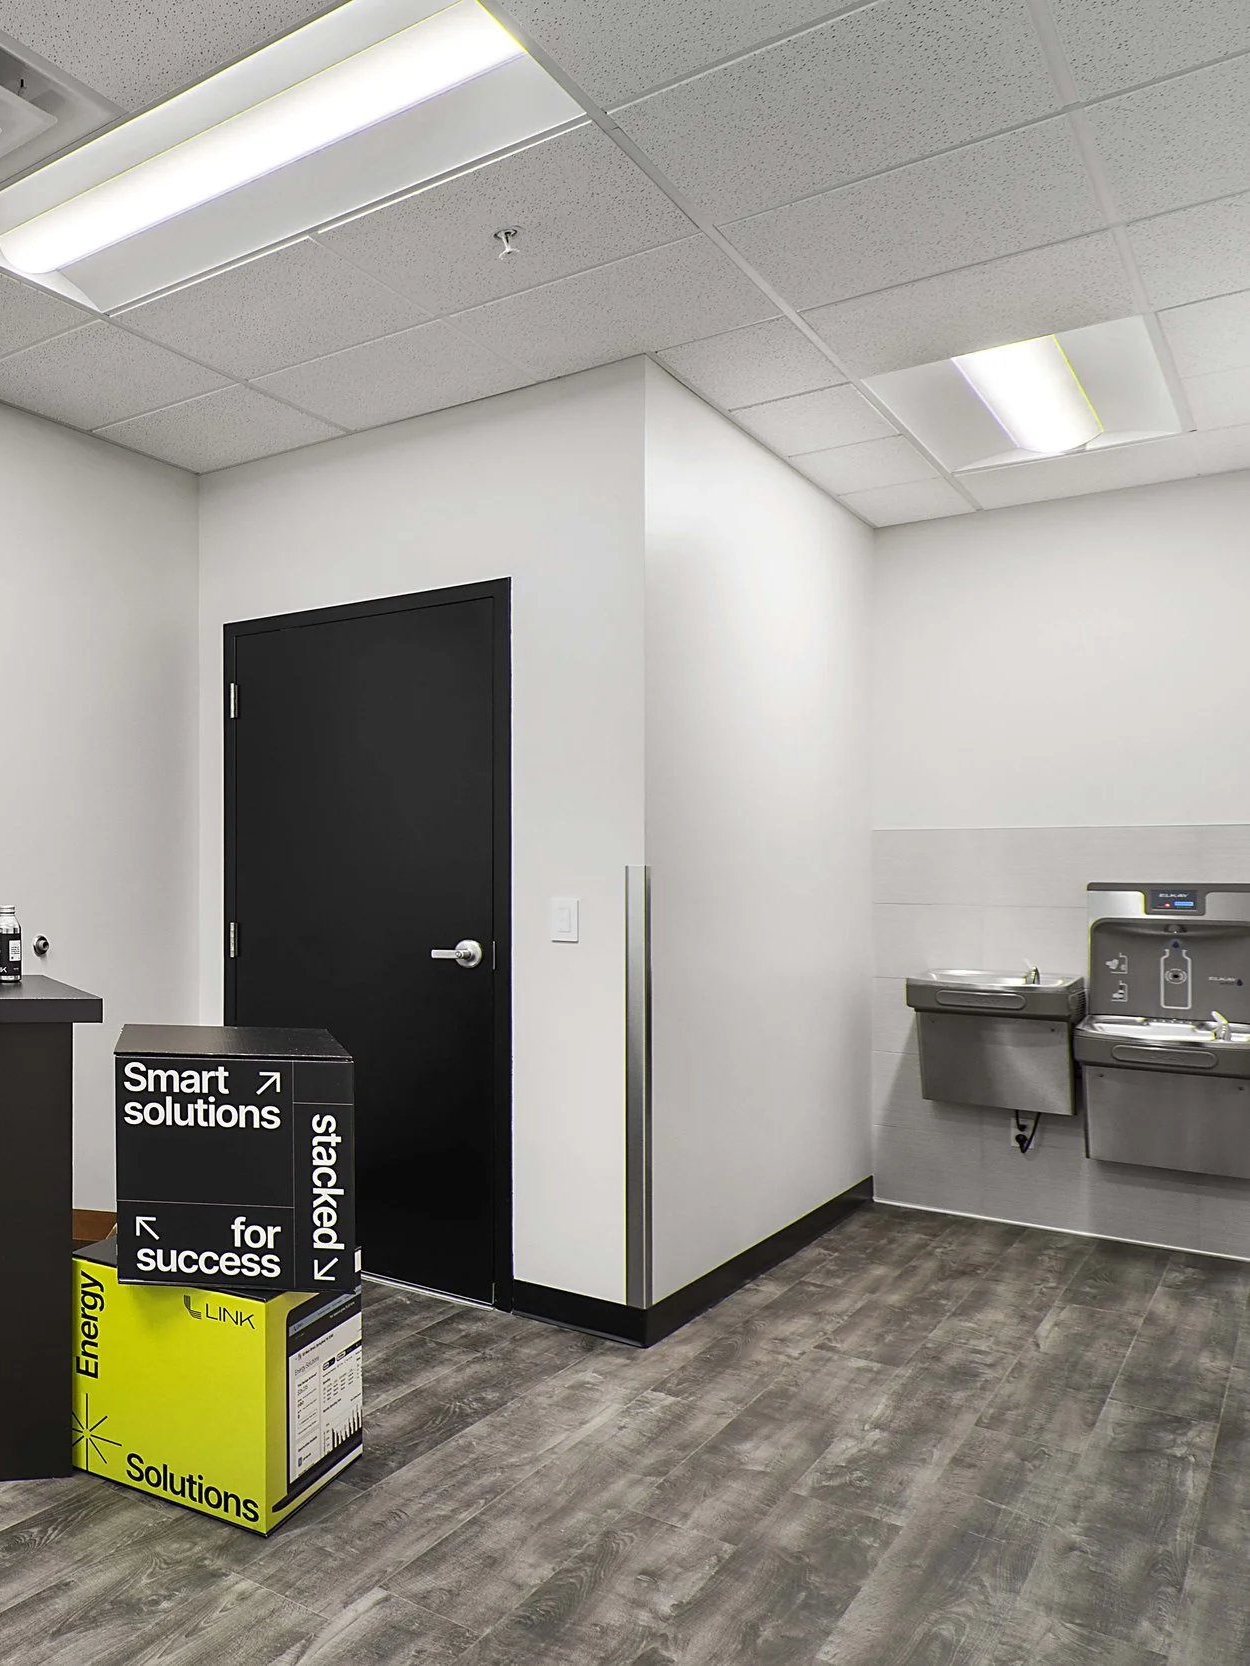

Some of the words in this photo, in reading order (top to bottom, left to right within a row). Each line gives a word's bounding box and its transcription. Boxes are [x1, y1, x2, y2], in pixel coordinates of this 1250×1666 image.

[123, 1061, 230, 1095] Smart
[123, 1095, 282, 1129] solutions
[311, 1113, 345, 1250] stacked
[231, 1216, 282, 1249] for
[136, 1247, 282, 1278] success
[76, 1270, 105, 1379] Energy
[205, 1303, 255, 1330] LINK
[125, 1452, 260, 1523] Solutions
